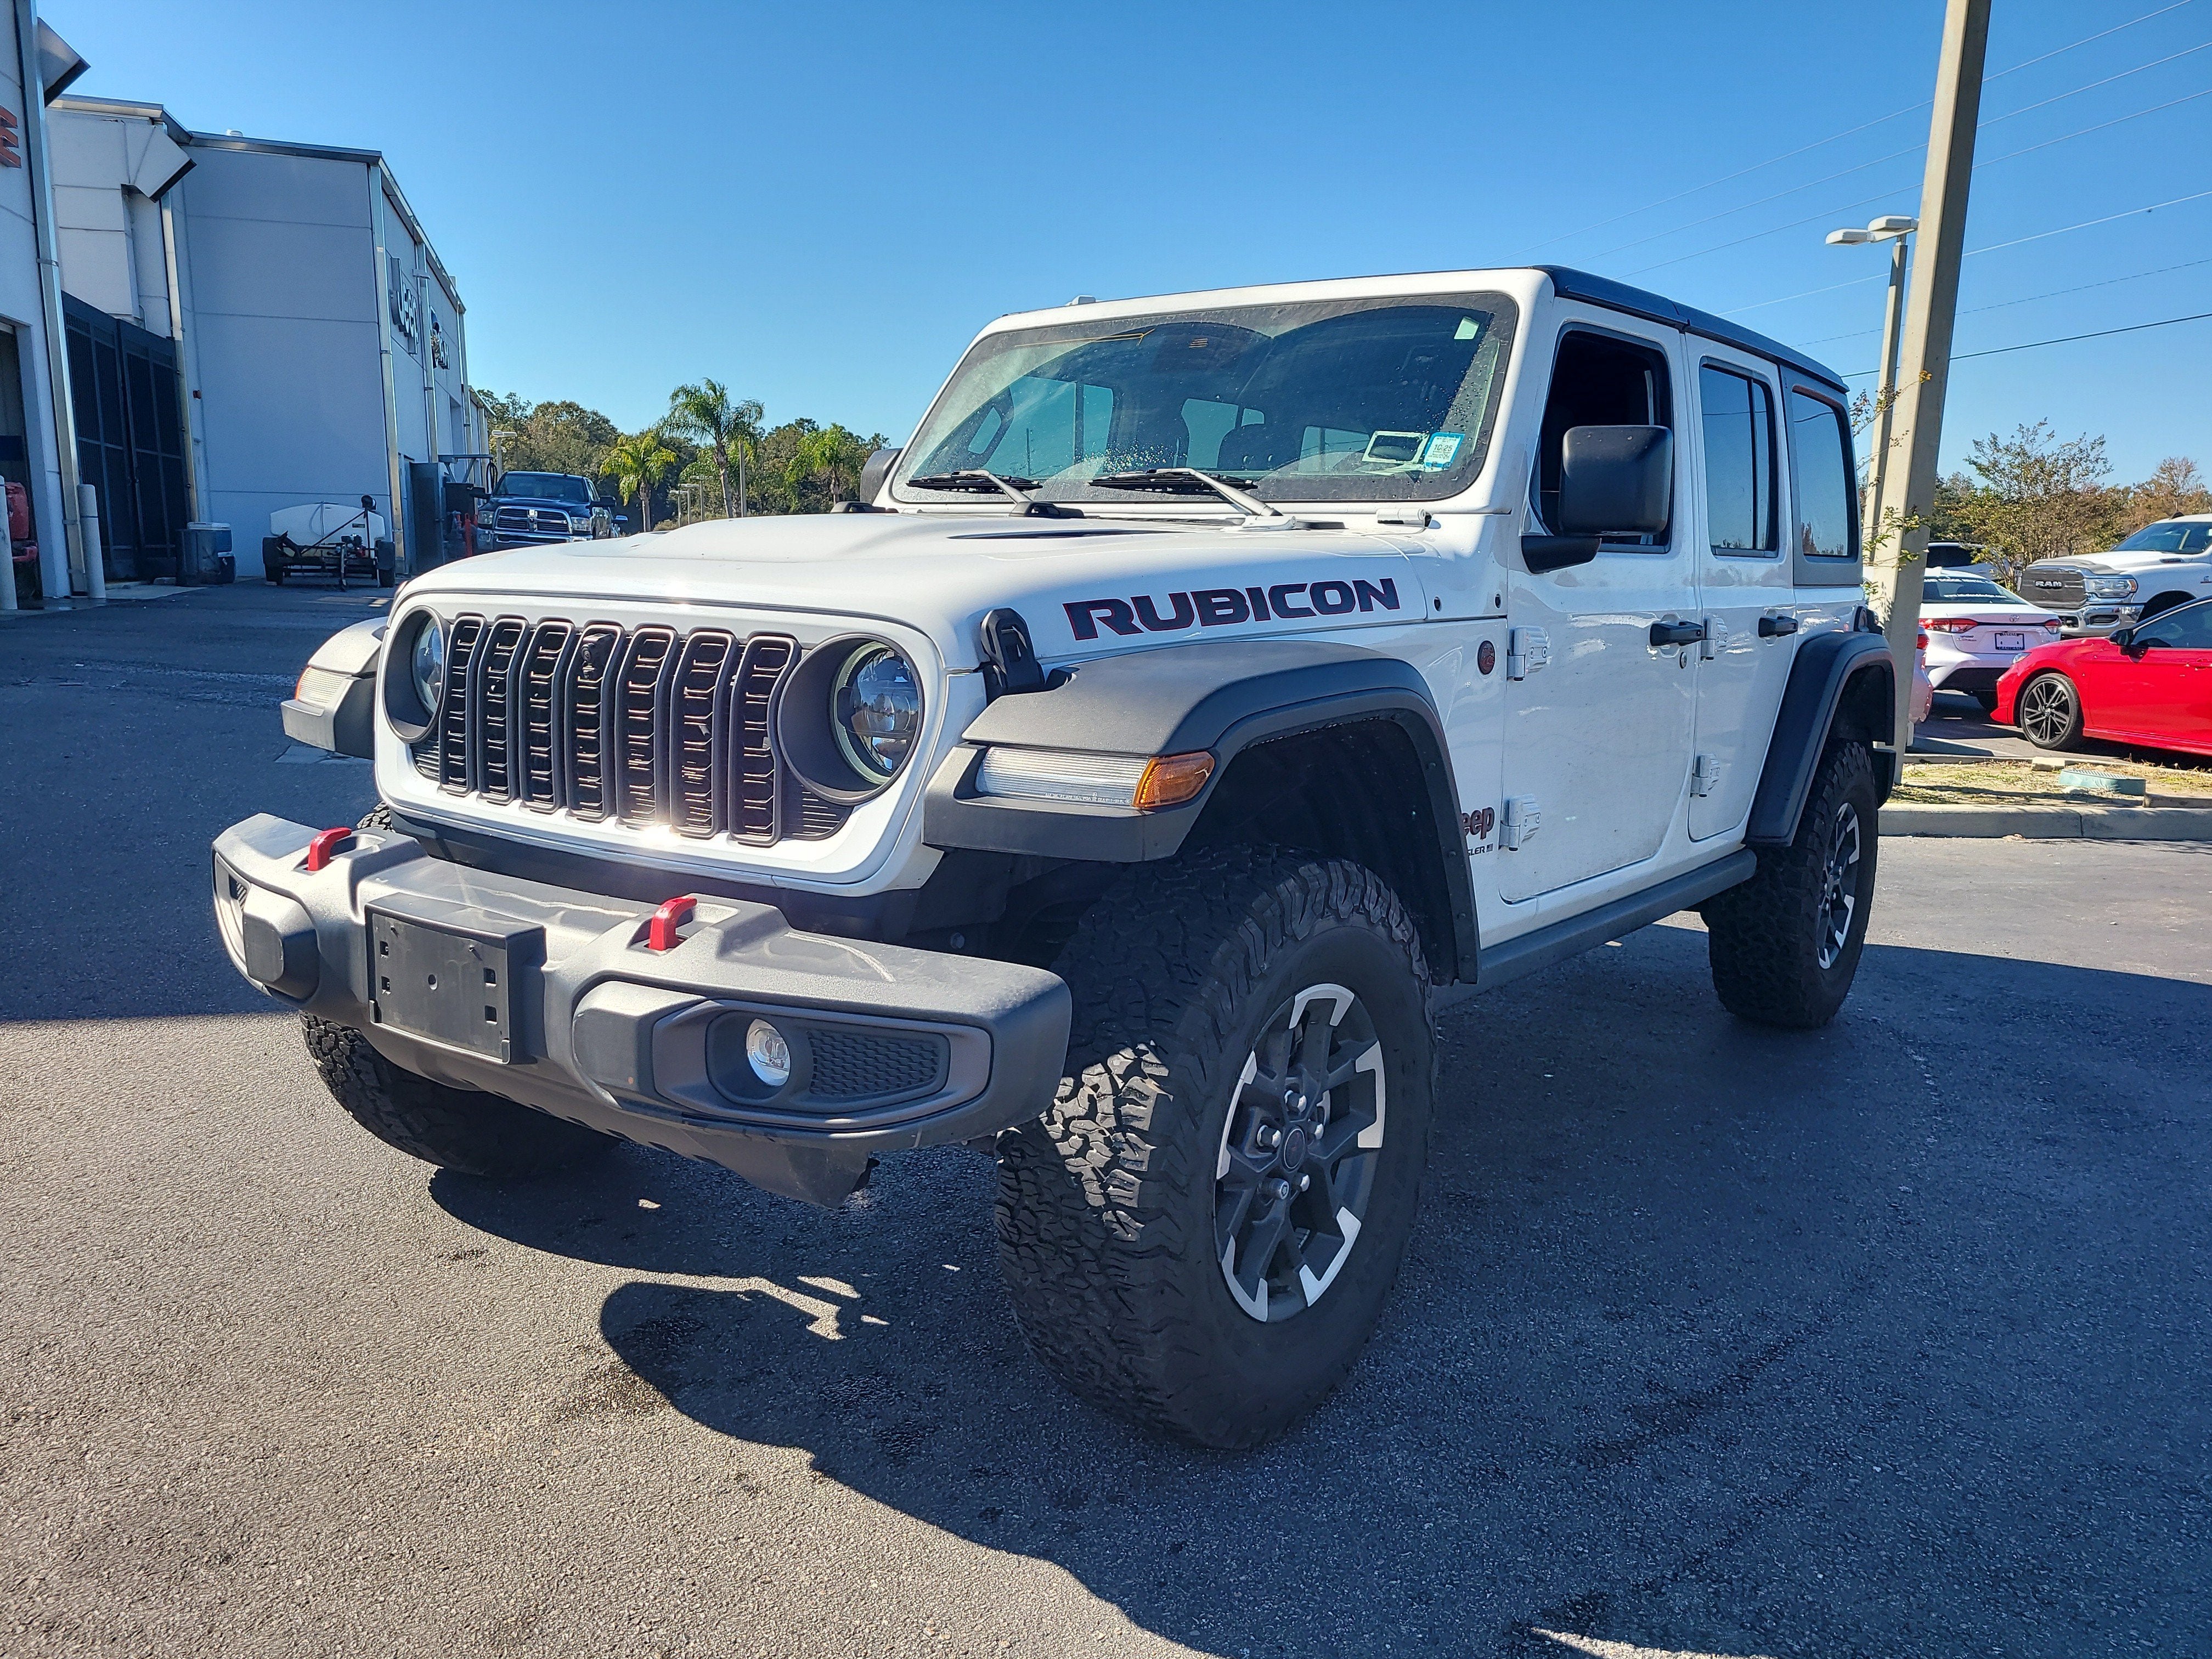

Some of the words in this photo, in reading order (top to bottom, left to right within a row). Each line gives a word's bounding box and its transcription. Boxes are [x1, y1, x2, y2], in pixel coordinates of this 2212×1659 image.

[390, 258, 419, 354] Jeep
[1063, 578, 1400, 641] RUBICON
[1461, 807, 1495, 840] eep
